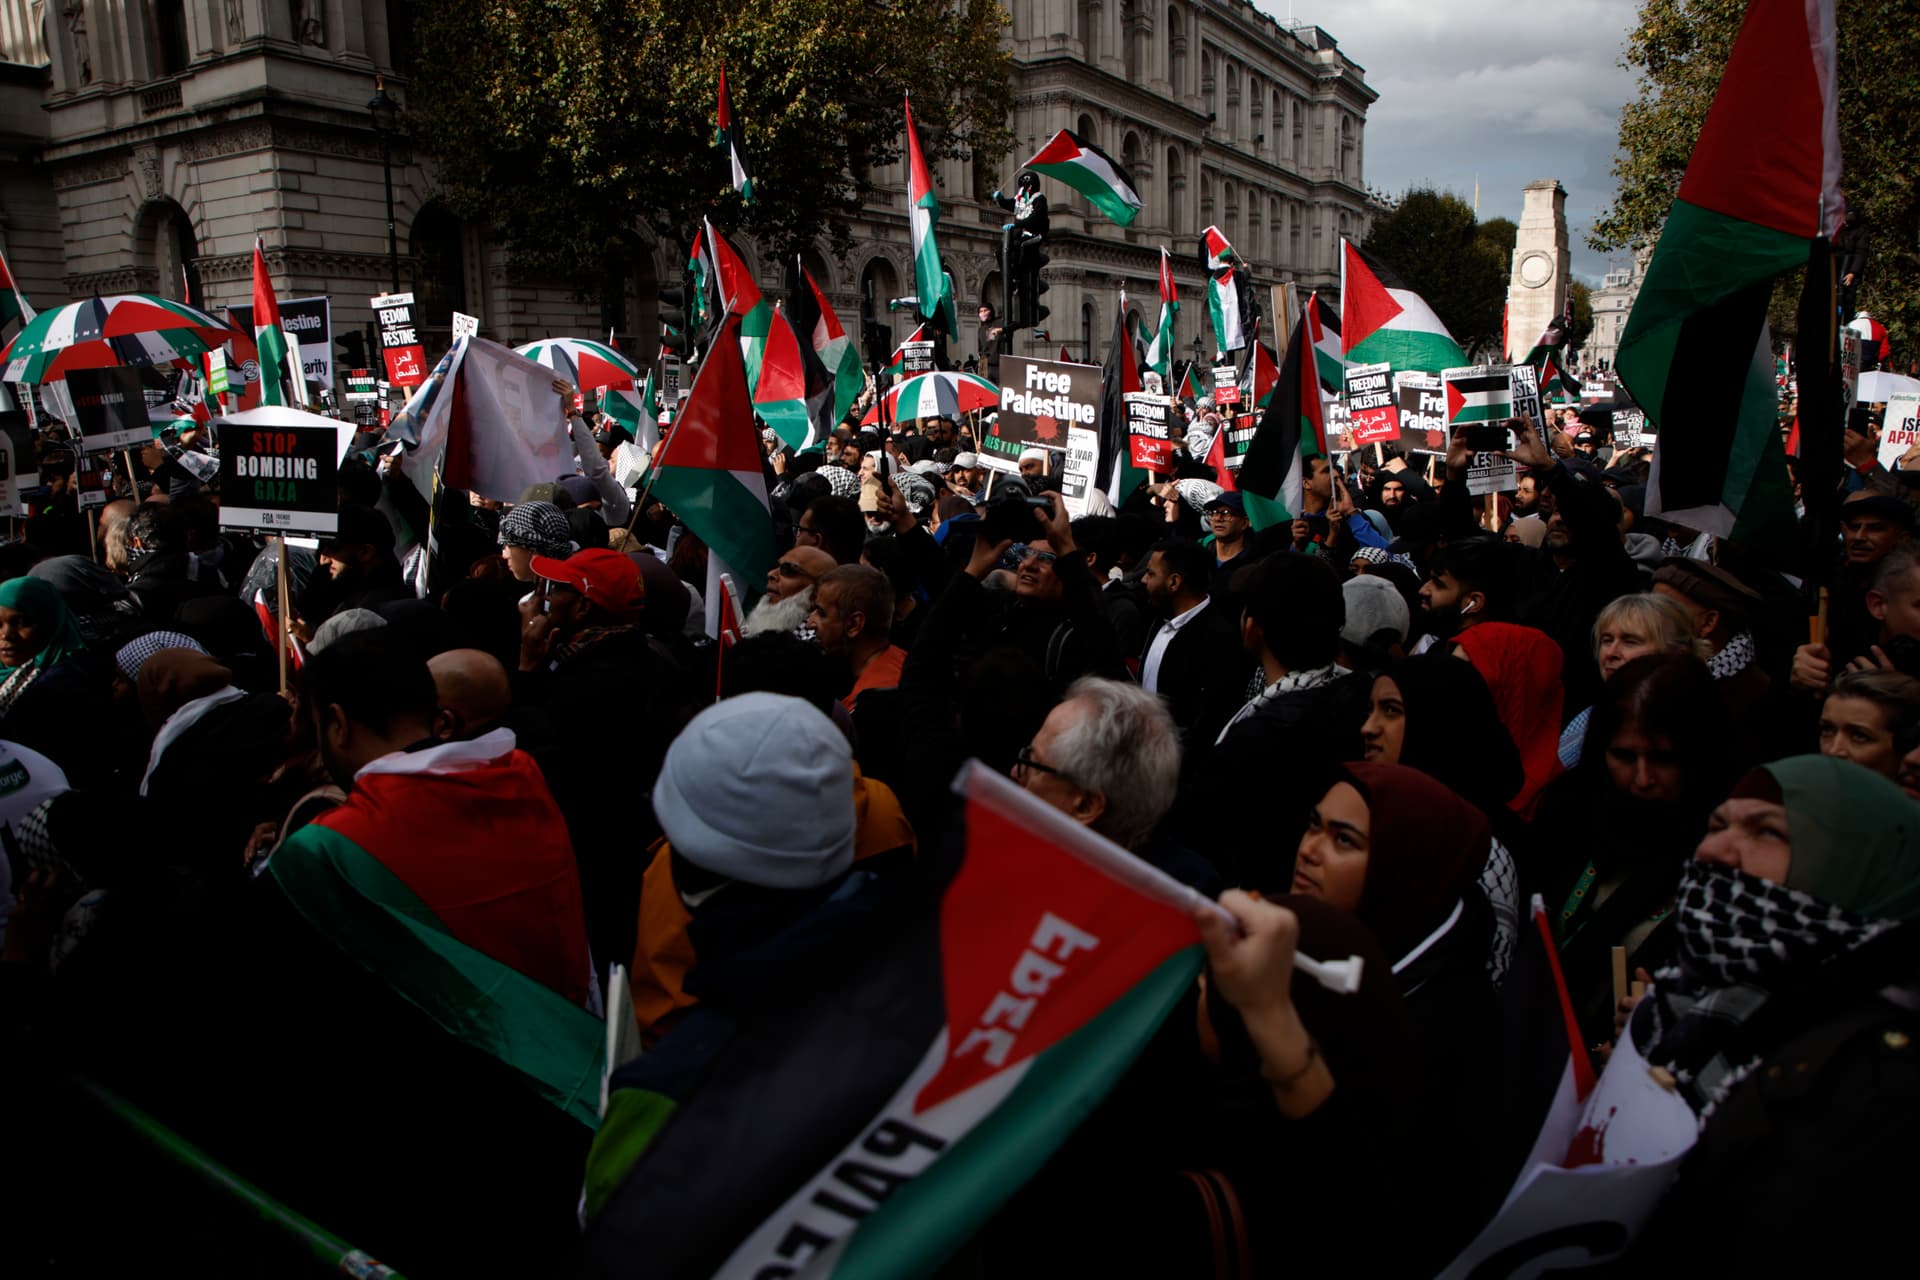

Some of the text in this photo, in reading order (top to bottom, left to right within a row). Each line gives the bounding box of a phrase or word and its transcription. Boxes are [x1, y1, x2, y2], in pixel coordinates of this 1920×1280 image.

[1026, 364, 1071, 394] Free
[1349, 374, 1386, 393] FREEDOM
[1001, 387, 1096, 425] Palestine
[1130, 402, 1165, 420] FREEDOM
[1350, 391, 1392, 411] PALESTINE
[1129, 420, 1168, 439] PALESTINE
[1235, 415, 1254, 430] STOP
[252, 431, 298, 455] STOP
[1075, 448, 1093, 462] WAR
[236, 455, 318, 480] BOMBING
[254, 480, 297, 503] GAZA
